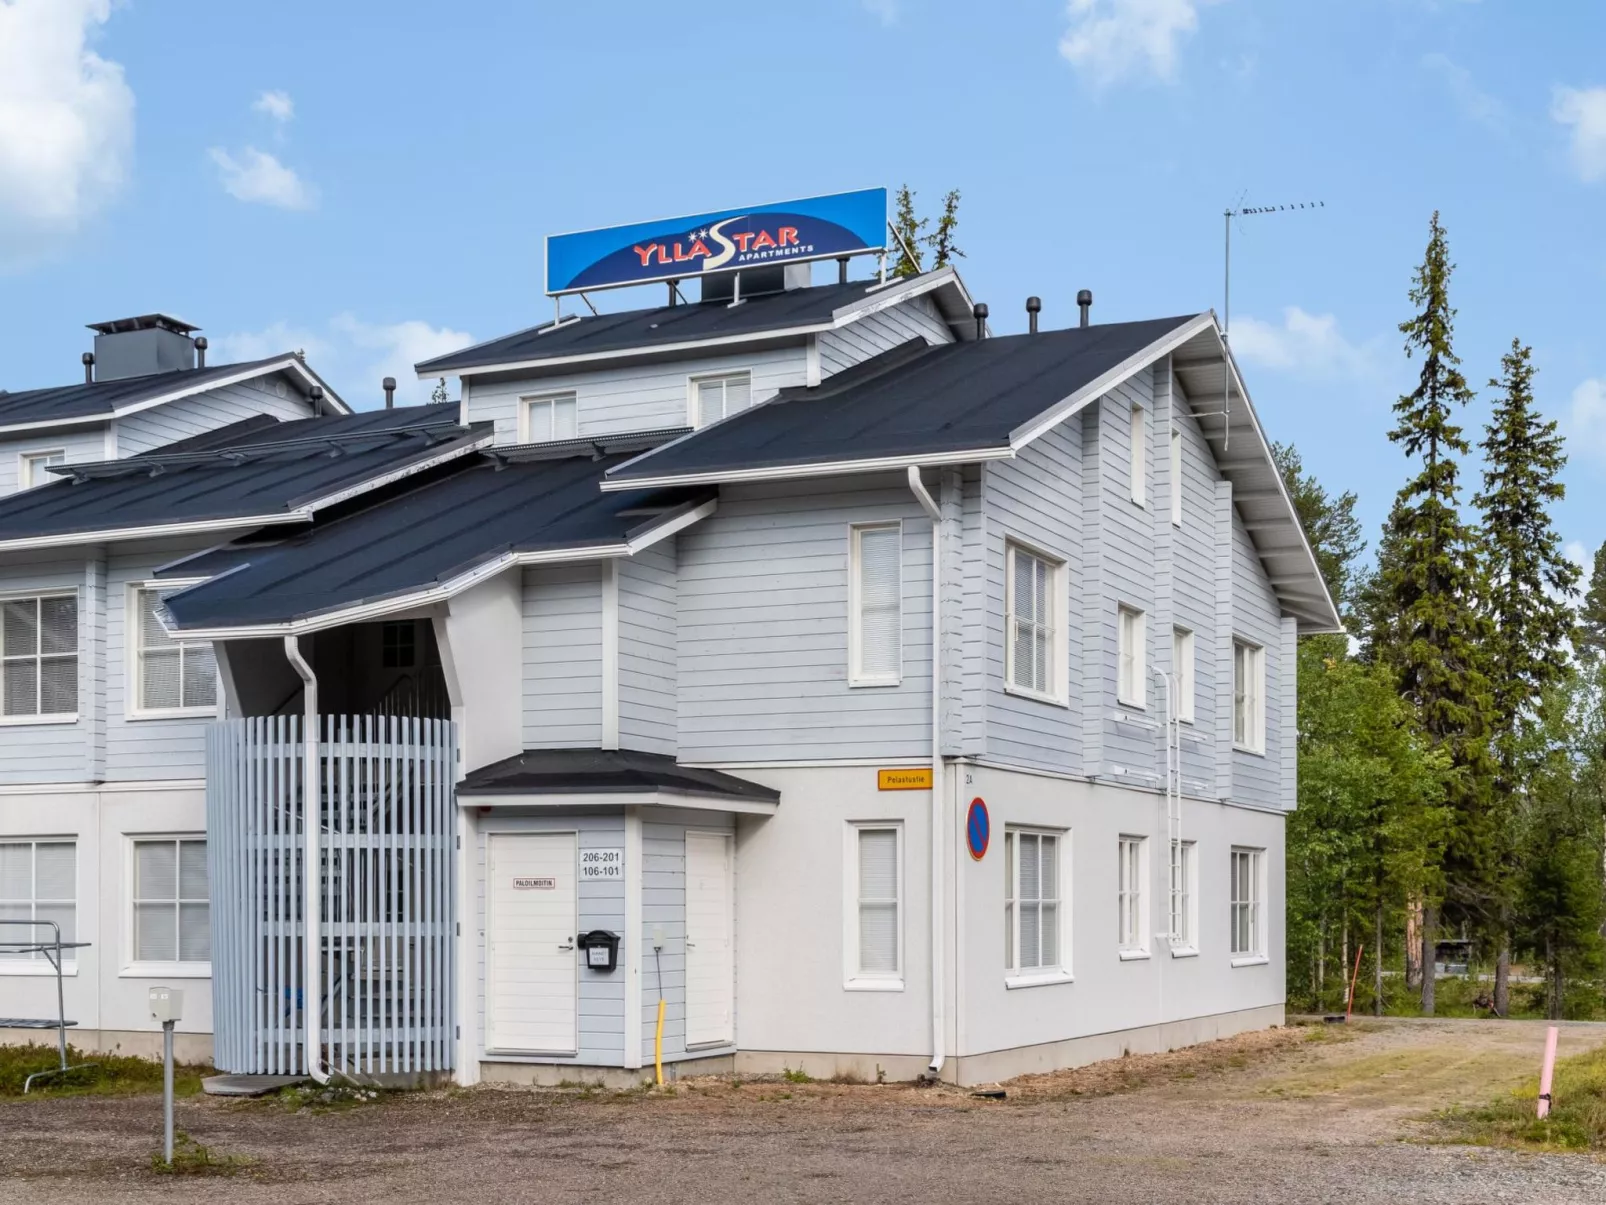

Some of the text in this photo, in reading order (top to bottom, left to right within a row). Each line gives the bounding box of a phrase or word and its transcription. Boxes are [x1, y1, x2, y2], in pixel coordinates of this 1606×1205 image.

[738, 245, 814, 262] APARTMENTS
[583, 852, 619, 862] 206-201
[583, 866, 619, 876] 106-101
